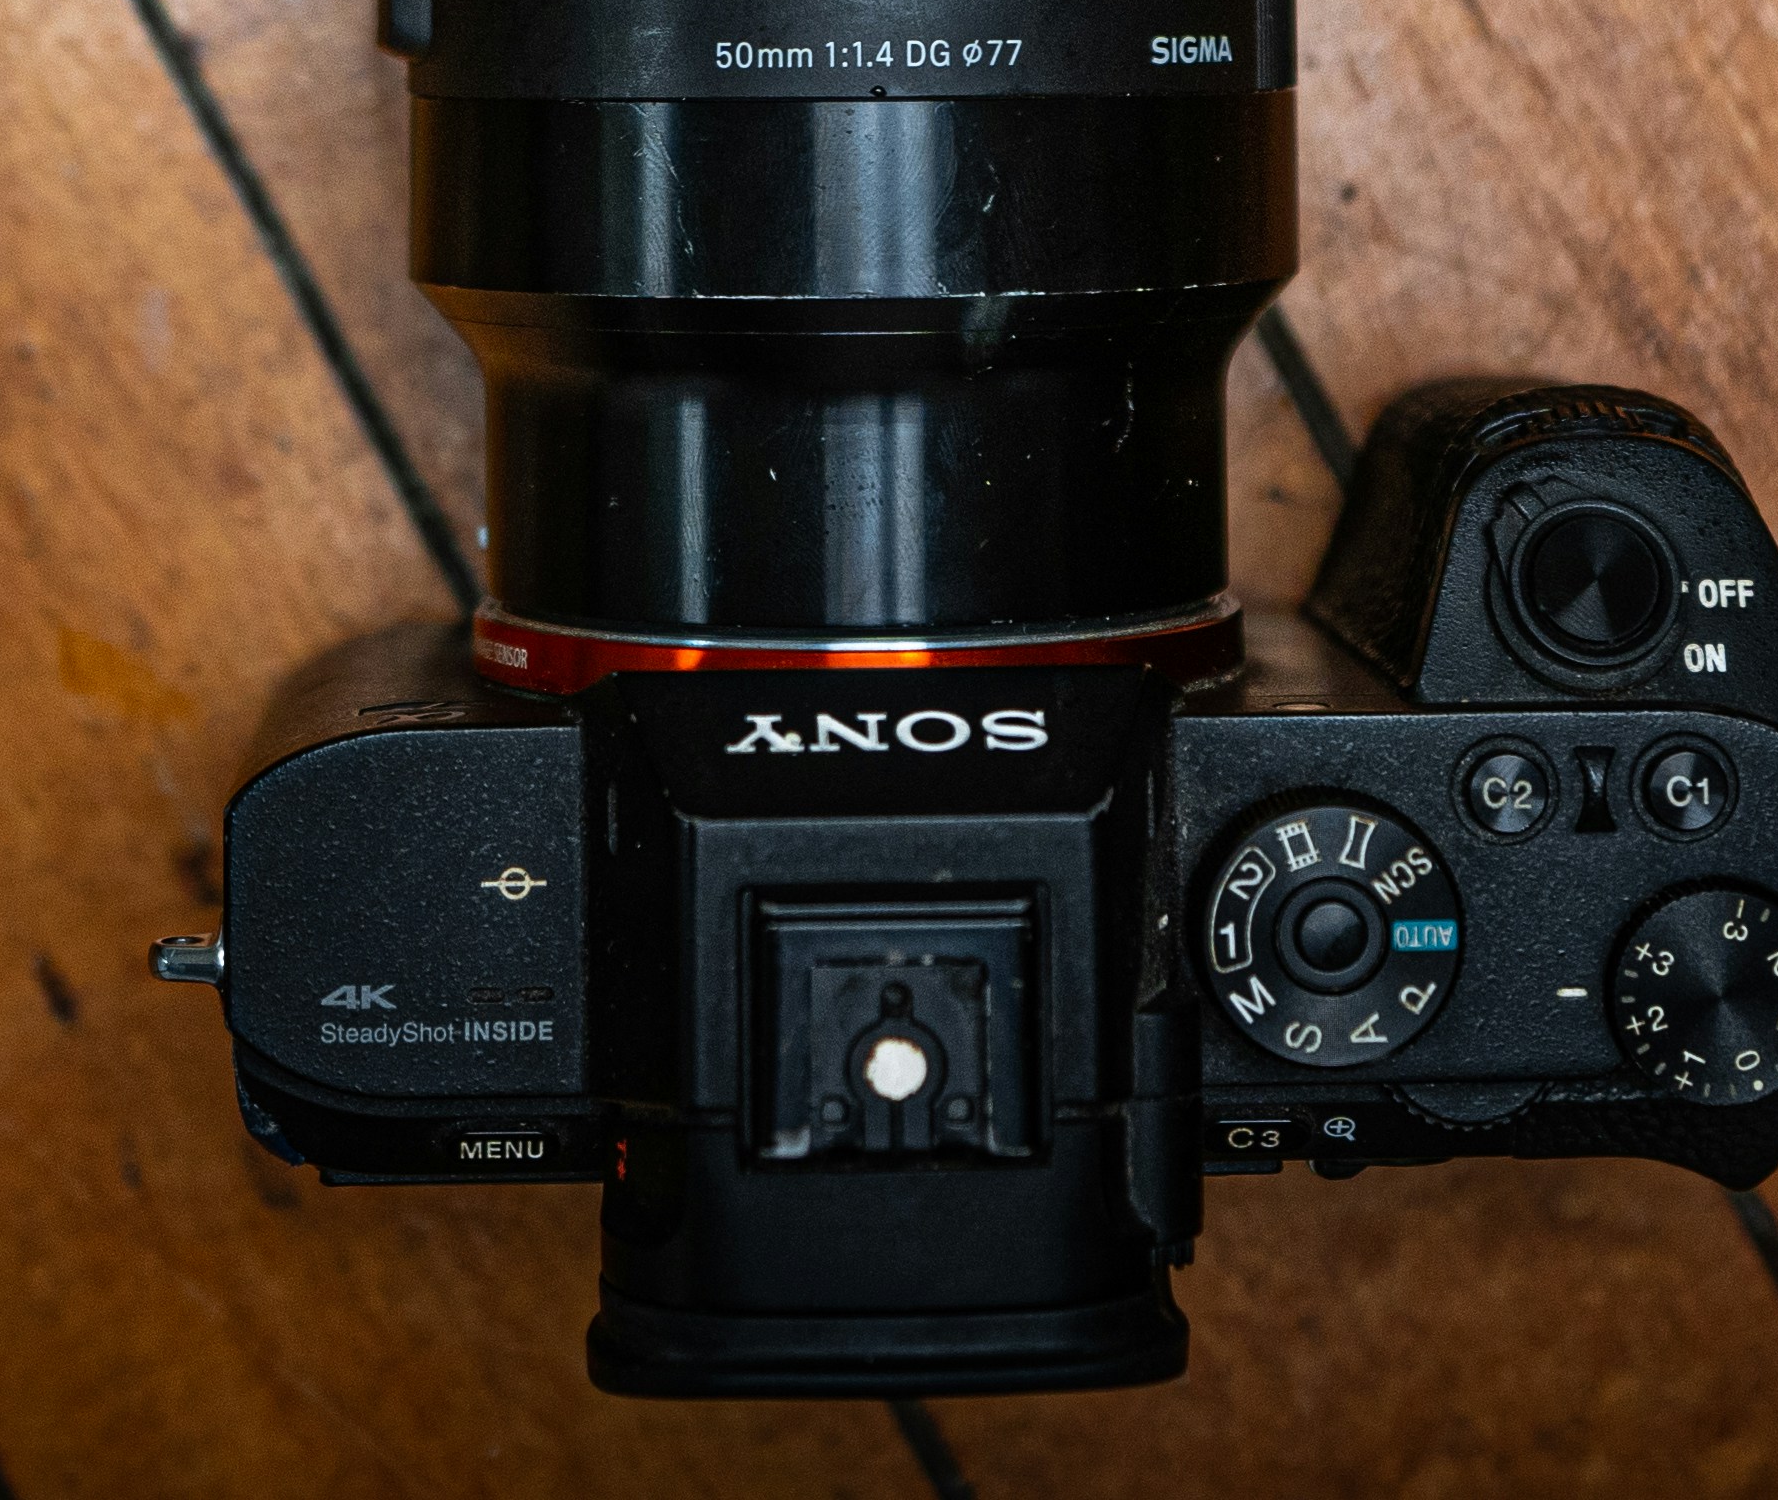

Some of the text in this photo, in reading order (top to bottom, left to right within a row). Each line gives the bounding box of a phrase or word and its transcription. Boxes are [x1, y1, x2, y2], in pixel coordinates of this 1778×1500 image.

[715, 41, 814, 69] 50mm
[824, 40, 895, 68] 1:1.4
[905, 39, 952, 68] DG
[1151, 36, 1234, 64] SIGMA
[1697, 580, 1755, 608] OFF
[1684, 643, 1727, 673] ON
[725, 710, 1050, 754] SONY
[1481, 776, 1533, 809] C2
[1665, 775, 1711, 806] C1
[1228, 862, 1264, 900] 2
[1372, 847, 1434, 904] SCN
[1220, 922, 1237, 959] 1
[1394, 925, 1453, 948] AUTO
[320, 984, 398, 1010] 4K
[1229, 975, 1277, 1025] M
[1399, 981, 1438, 1015] P
[320, 1020, 554, 1046] SteadyShot INSIDE
[1285, 1021, 1323, 1053] S
[1350, 1012, 1389, 1044] A
[459, 1140, 545, 1159] MENU
[1228, 1127, 1280, 1149] C3
